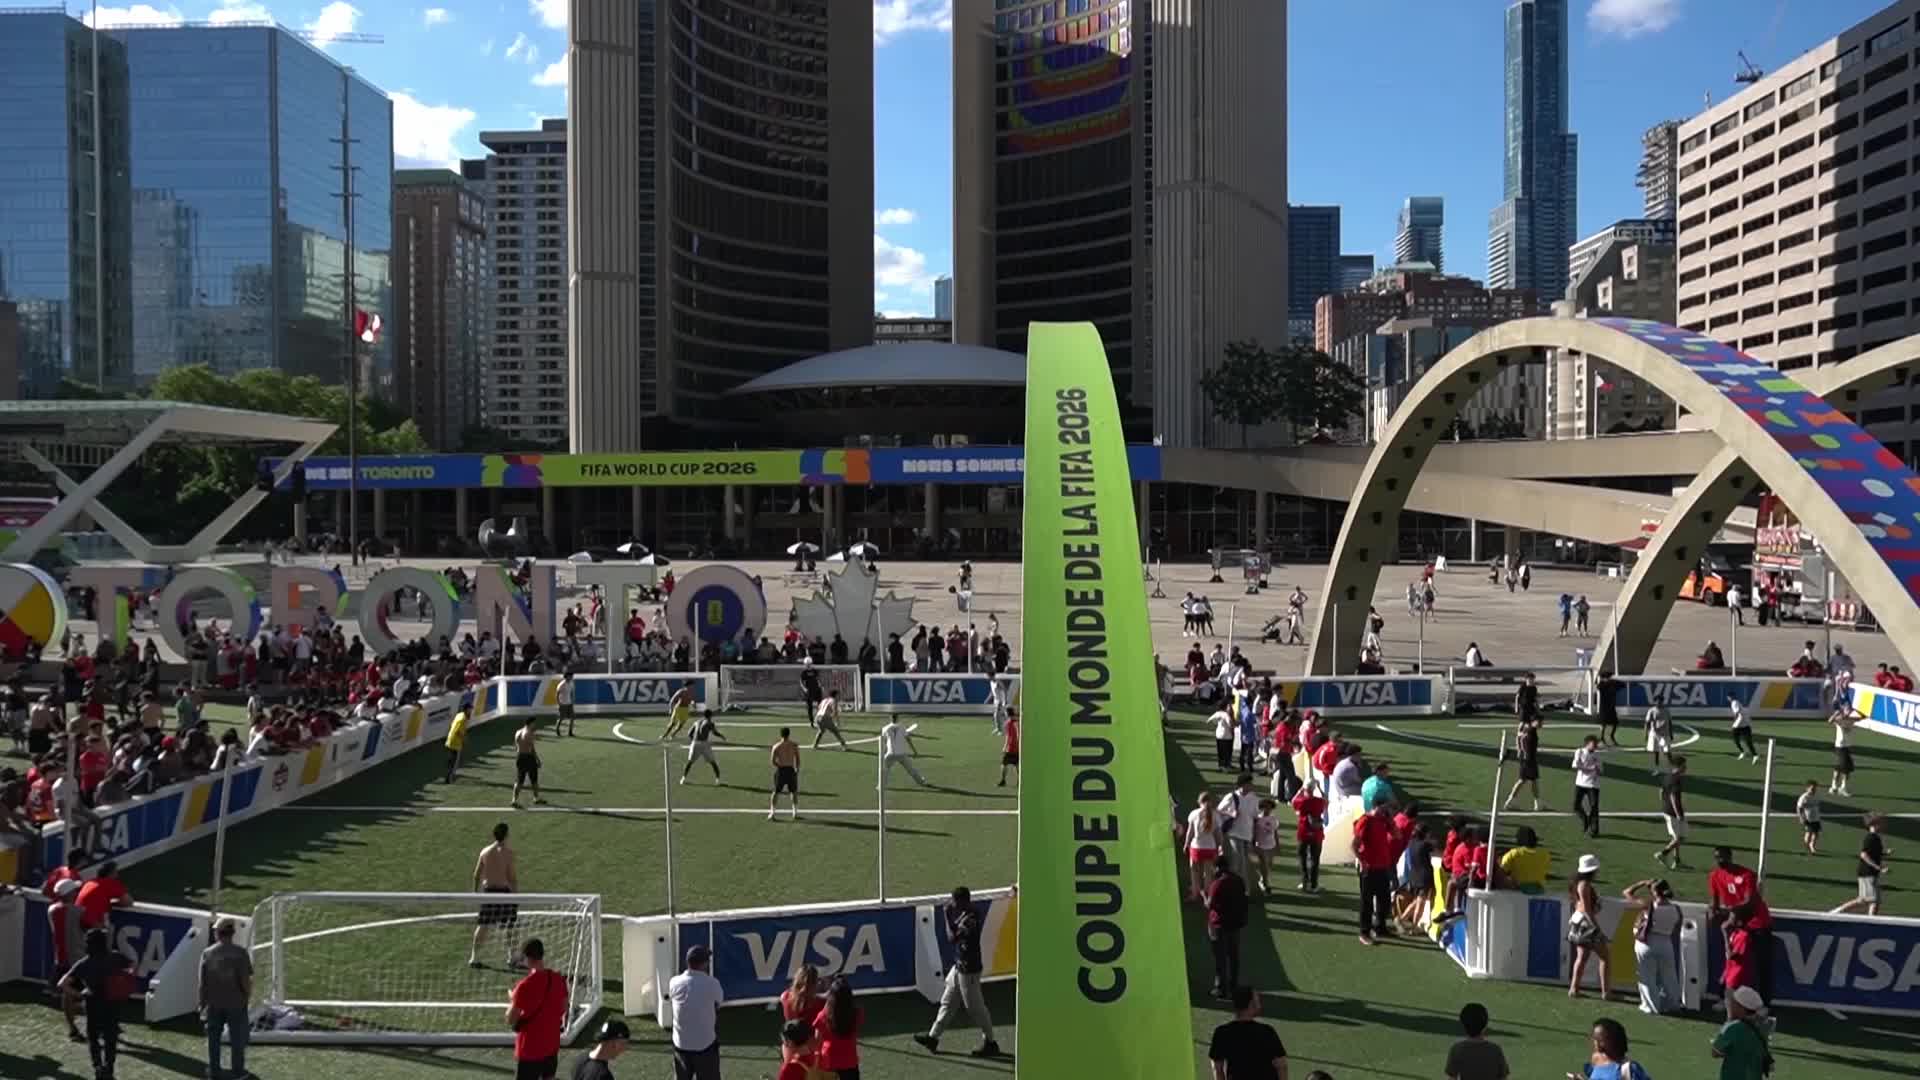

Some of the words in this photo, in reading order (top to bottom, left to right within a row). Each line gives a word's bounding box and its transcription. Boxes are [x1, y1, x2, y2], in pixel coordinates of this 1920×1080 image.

[1056, 388, 1091, 445] 2026
[360, 466, 434, 479] TORONTO
[580, 463, 611, 476] FIFA
[613, 463, 667, 476] WORLD
[670, 463, 700, 476] CUP
[702, 461, 758, 475] 2026
[1060, 450, 1096, 497] FIFA
[1061, 503, 1099, 536] LA
[1063, 543, 1103, 581] DE
[1066, 588, 1112, 725] MONDE
[607, 680, 670, 702] VISA
[902, 680, 966, 702] VISA
[1333, 681, 1397, 705] VISA
[1640, 681, 1708, 705] VISA
[1072, 737, 1117, 801] DU
[1076, 814, 1128, 1004] COUPE
[731, 923, 887, 982] VISA
